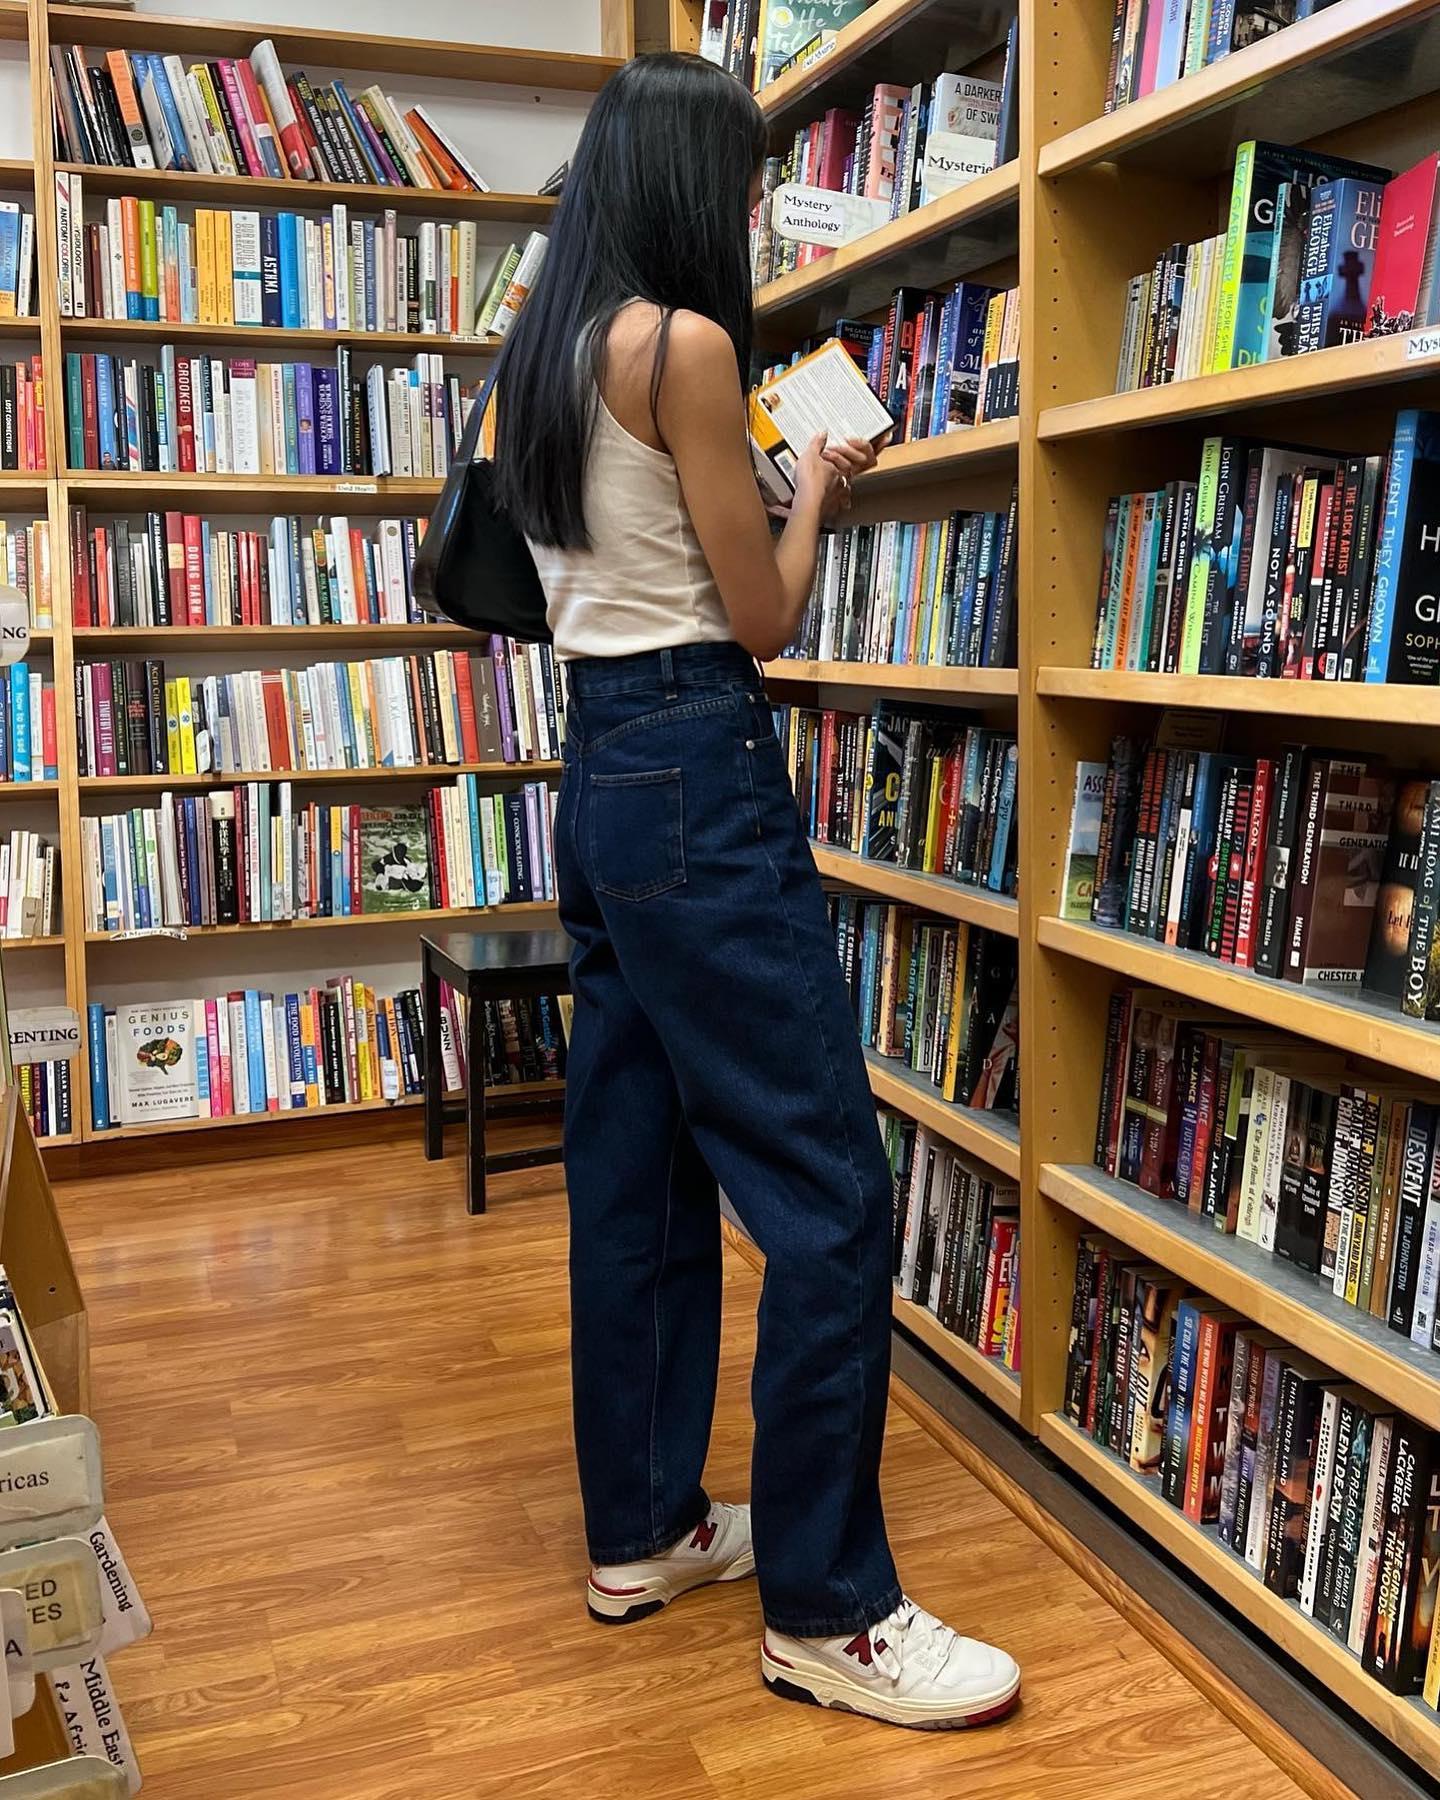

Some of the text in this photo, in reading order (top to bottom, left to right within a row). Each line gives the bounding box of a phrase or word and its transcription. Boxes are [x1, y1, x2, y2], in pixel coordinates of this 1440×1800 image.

[928, 156, 993, 175] Mysterie
[60, 207, 69, 242] ANATOMY
[783, 215, 841, 232] Anthology
[784, 194, 832, 212] Mystery
[1307, 216, 1322, 277] GEORGE
[1318, 213, 1332, 272] Elizabeth
[263, 256, 278, 293] ASTHMA
[178, 362, 191, 413] CROOKED
[5, 399, 13, 453] LOST CONNECTIONS
[1198, 444, 1215, 523] JOHN GRISHAM
[1214, 446, 1233, 540] JOHN GRISHAM
[1162, 497, 1174, 562] MARTHA GRIMES
[1176, 492, 1191, 580] MARTHA GRIMES
[1337, 485, 1357, 576] THE LOCK ARTIST
[187, 546, 202, 614] DOING HARM
[973, 532, 992, 625] SANDRA BROWN
[1258, 547, 1280, 655] NOT A SOUND
[1372, 526, 1395, 643] THEY GROWN
[1318, 626, 1326, 649] HALL
[15, 693, 24, 708] how
[16, 710, 24, 720] to
[151, 665, 161, 716] ACID CHRIST
[17, 724, 25, 734] be
[980, 767, 990, 812] Cleeves
[990, 768, 1002, 814] Cleeves
[1000, 799, 1011, 821] Spy
[513, 817, 524, 880] CONSCIOUS EATING
[1135, 839, 1145, 870] PATRICIA
[1145, 840, 1155, 871] PATRICIA
[1211, 778, 1238, 939] SARAH HILARY SOMEONE SKIN
[1237, 800, 1262, 939] HILTON MAESTRA
[1292, 771, 1321, 947] THE THIRD GENERATION HIMES
[1131, 871, 1143, 910] HIGHSMITH
[1140, 873, 1154, 913] HIGHSMITH
[1263, 888, 1276, 947] James Sallis
[845, 936, 854, 984] CONNOLLY
[1318, 970, 1357, 982] CHESTER
[1407, 915, 1429, 1008] THE BOY
[129, 1011, 189, 1024] GENIUS
[134, 1024, 185, 1036] FOODS
[904, 959, 917, 1049] ROBERT CRAIS
[290, 1002, 303, 1080] THE FOOD REVOLUTION
[440, 1016, 452, 1050] BUZZ
[153, 1096, 193, 1105] LUGAVERE
[1199, 1090, 1210, 1125] JANCE
[1183, 1127, 1193, 1162] JUSTICE
[1327, 1096, 1353, 1211] CRAIG JOHNSON
[1207, 1174, 1218, 1213] JANCE
[1397, 1126, 1428, 1291] DESCENT TIM JOHNSTON
[1348, 1217, 1366, 1284] JUNKYARD DOGS
[1426, 1220, 1438, 1252] RAGNAR
[1115, 1308, 1129, 1380] GROTESQUE
[1129, 1347, 1140, 1393] KIRINO
[1136, 1372, 1149, 1411] OUT
[1170, 1316, 1193, 1468] SO COLD THE RIVER MICHAEL KORYTA
[1192, 1323, 1213, 1461] THOSE WHO WISH DEAD MICHAEL
[1280, 1381, 1298, 1486] THIS TENDER LAND
[1336, 1413, 1352, 1465] SILENT
[1391, 1438, 1408, 1515] LACKBERG
[1402, 1454, 1415, 1507] CAMILLA
[1269, 1506, 1279, 1550] KRUEGER
[1275, 1500, 1287, 1566] WILLIAM KENT
[1340, 1466, 1361, 1552] PREACHER
[689, 1520, 718, 1552] N
[1394, 1540, 1405, 1566] THE
[88, 1531, 133, 1612] Gardening
[1340, 1565, 1351, 1610] CAMILLA
[1377, 1530, 1397, 1617] THE WOODS
[80, 1658, 125, 1767] Middle East
